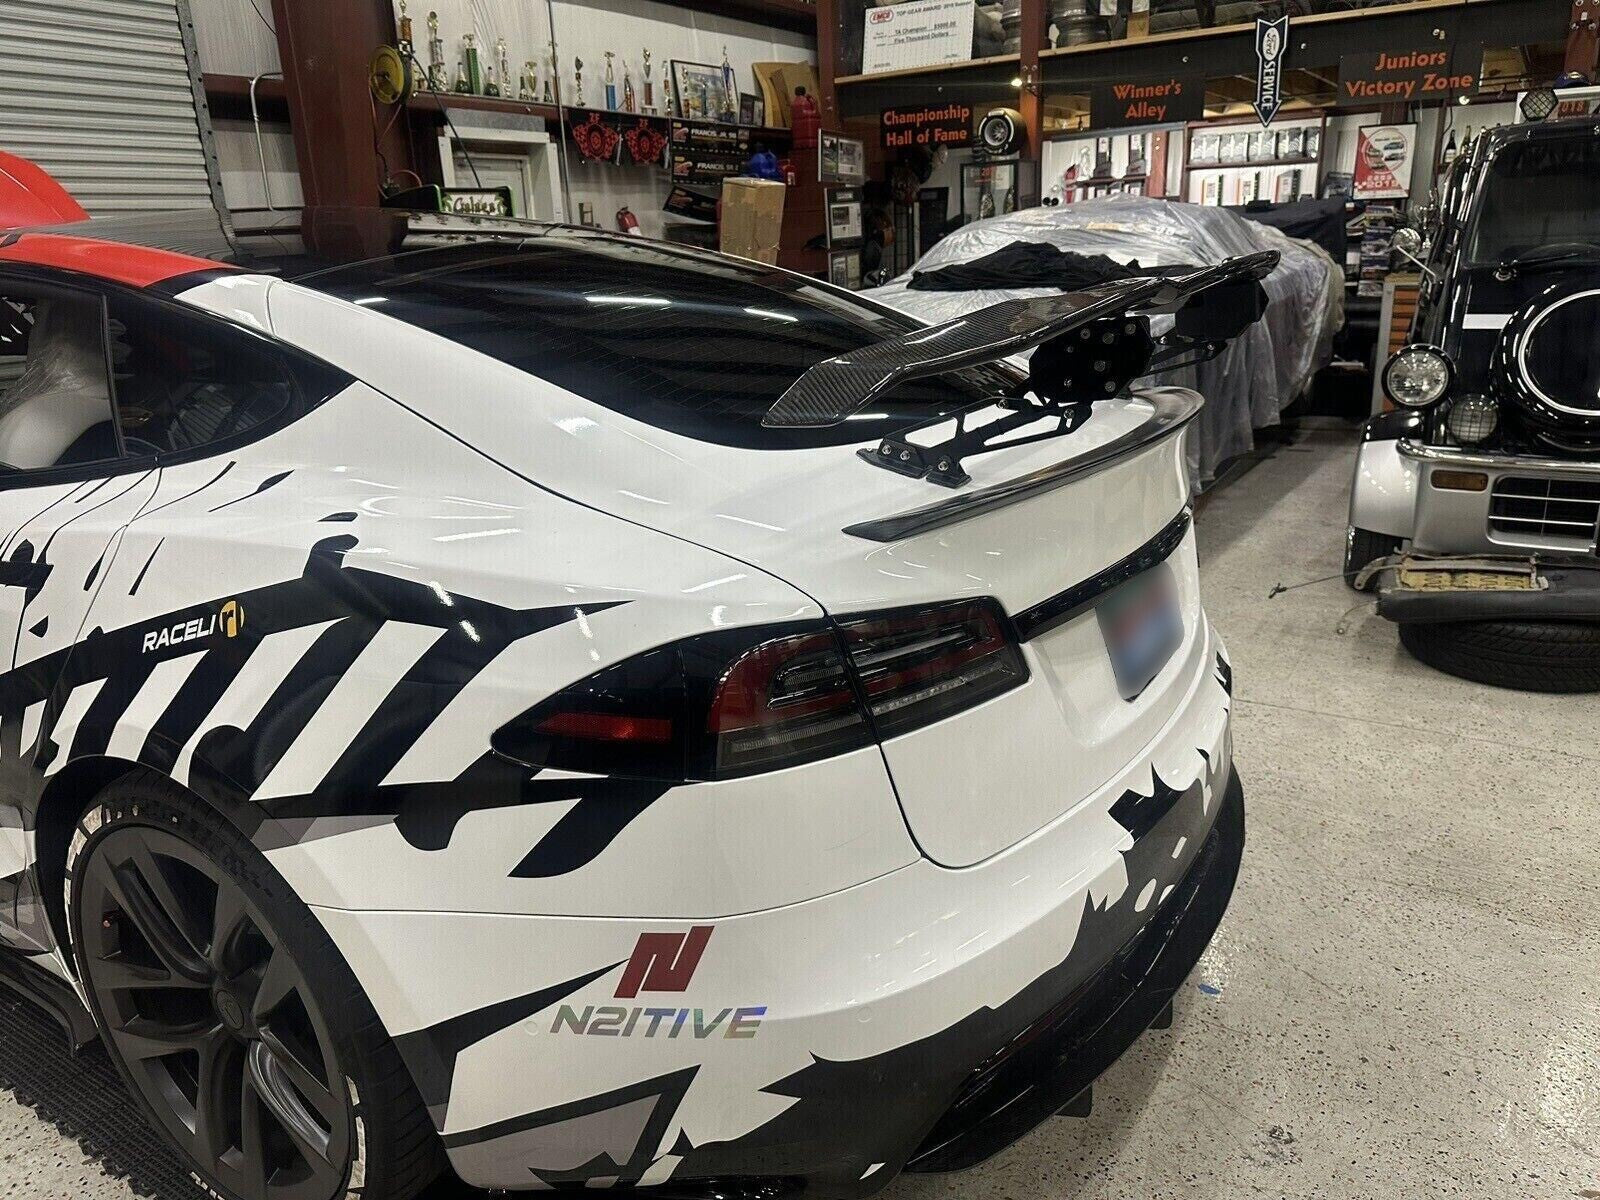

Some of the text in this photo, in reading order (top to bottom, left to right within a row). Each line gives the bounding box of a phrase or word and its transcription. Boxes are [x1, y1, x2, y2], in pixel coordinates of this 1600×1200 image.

[902, 26, 928, 35] Champion
[905, 34, 931, 43] Thousand
[931, 32, 949, 40] Dollars
[1374, 51, 1447, 71] Juniors
[1113, 79, 1182, 99] Winner's
[1261, 60, 1276, 110] SERVICE
[1345, 73, 1473, 99] Victory Zone
[883, 105, 970, 128] Championship
[1125, 101, 1167, 121] Alley
[886, 128, 968, 147] Hall of Fame
[142, 614, 217, 654] RACELI
[550, 1004, 768, 1040] N2ITIVE
